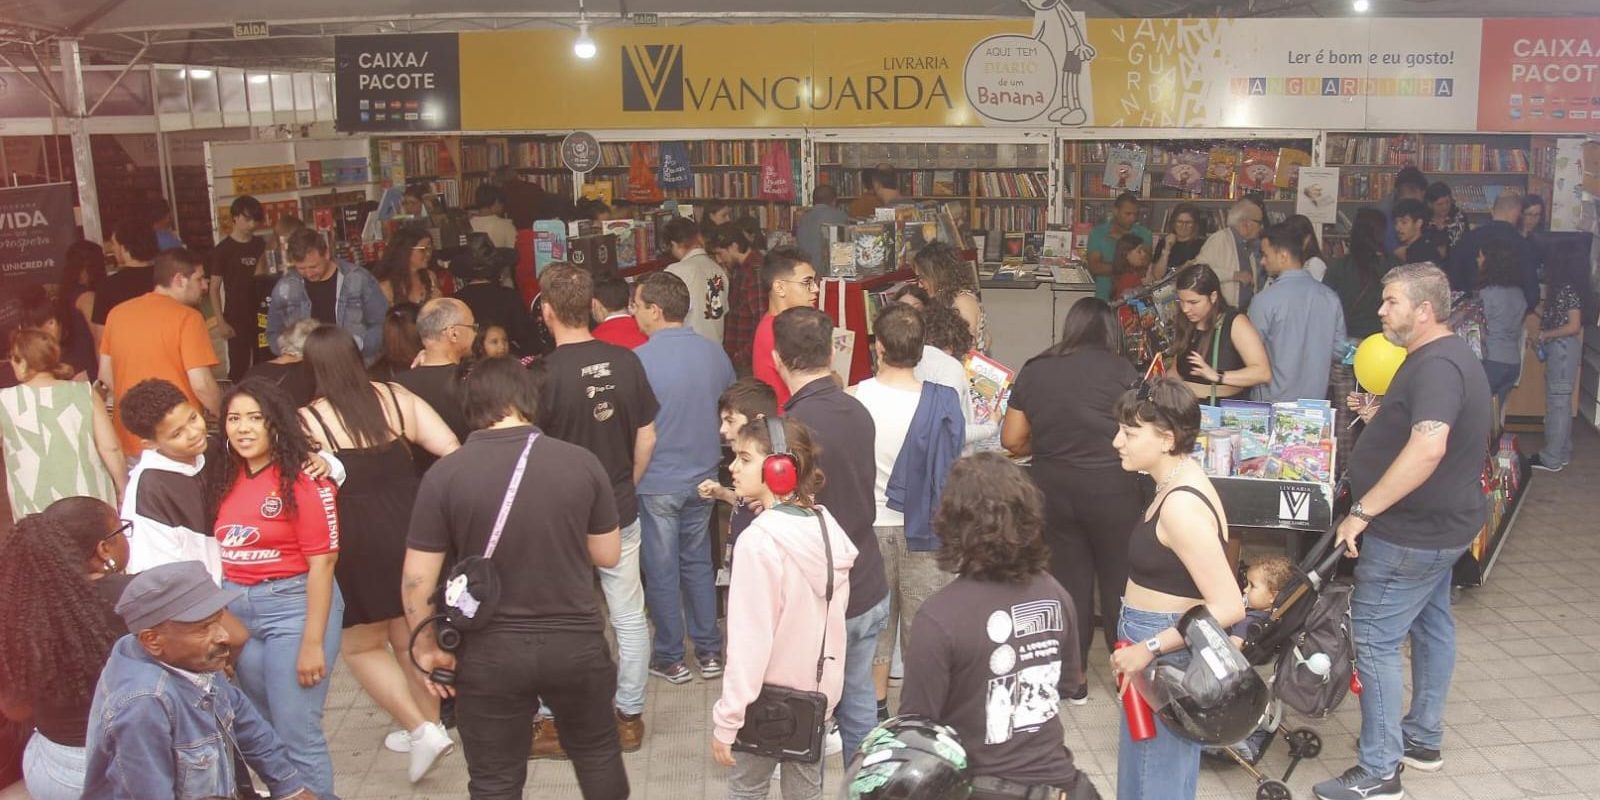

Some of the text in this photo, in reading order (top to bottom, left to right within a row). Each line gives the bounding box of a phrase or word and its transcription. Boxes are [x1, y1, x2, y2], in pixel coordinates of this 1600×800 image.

[985, 47, 1038, 57] AQUI TEM
[1287, 48, 1455, 68] Ler é bom e eu gosto!
[883, 56, 950, 71] LIVRARIA
[359, 73, 435, 90] PACOTE
[998, 77, 1008, 86] de
[1511, 64, 1600, 83] PACOT
[684, 75, 954, 111] VANGUARDA
[977, 86, 1044, 106] Banana
[2, 260, 43, 272] UNICRED
[317, 486, 339, 550] MULTISOM
